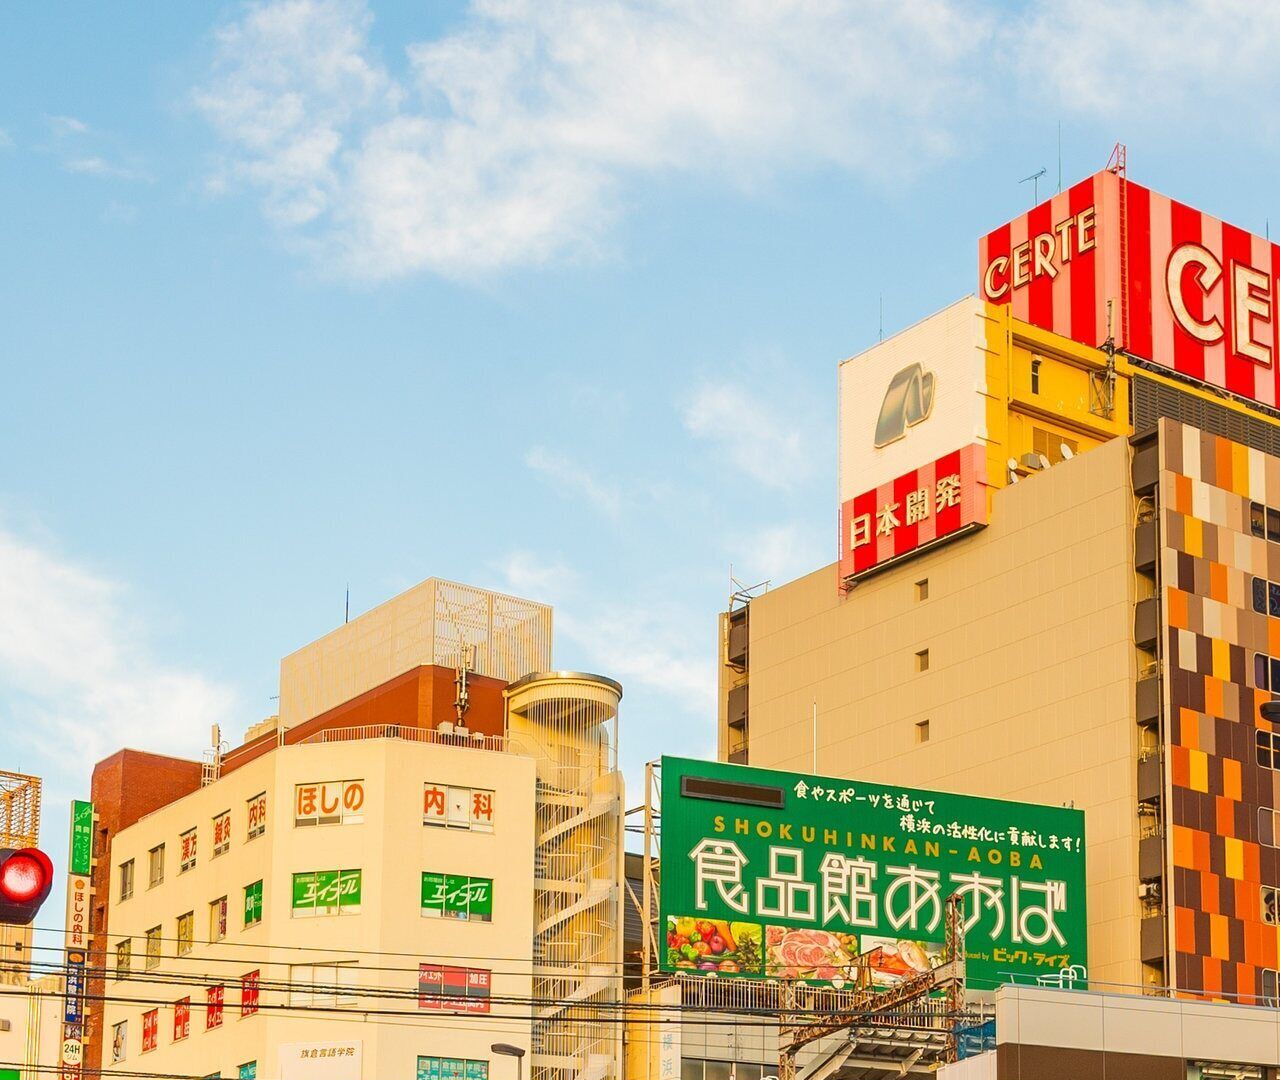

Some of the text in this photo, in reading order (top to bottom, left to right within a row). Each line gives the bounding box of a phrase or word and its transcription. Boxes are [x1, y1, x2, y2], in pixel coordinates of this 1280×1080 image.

[983, 203, 1098, 301] CERTE
[849, 473, 961, 551] 日本開発
[297, 783, 365, 816] ほしの
[423, 786, 493, 822] 内科
[793, 780, 936, 816] 食やスポーツを通じて
[899, 814, 1081, 854] 横浜の活性化に貢献します!
[687, 837, 1069, 948] 食品館あおば
[72, 891, 84, 945] ほしの内科
